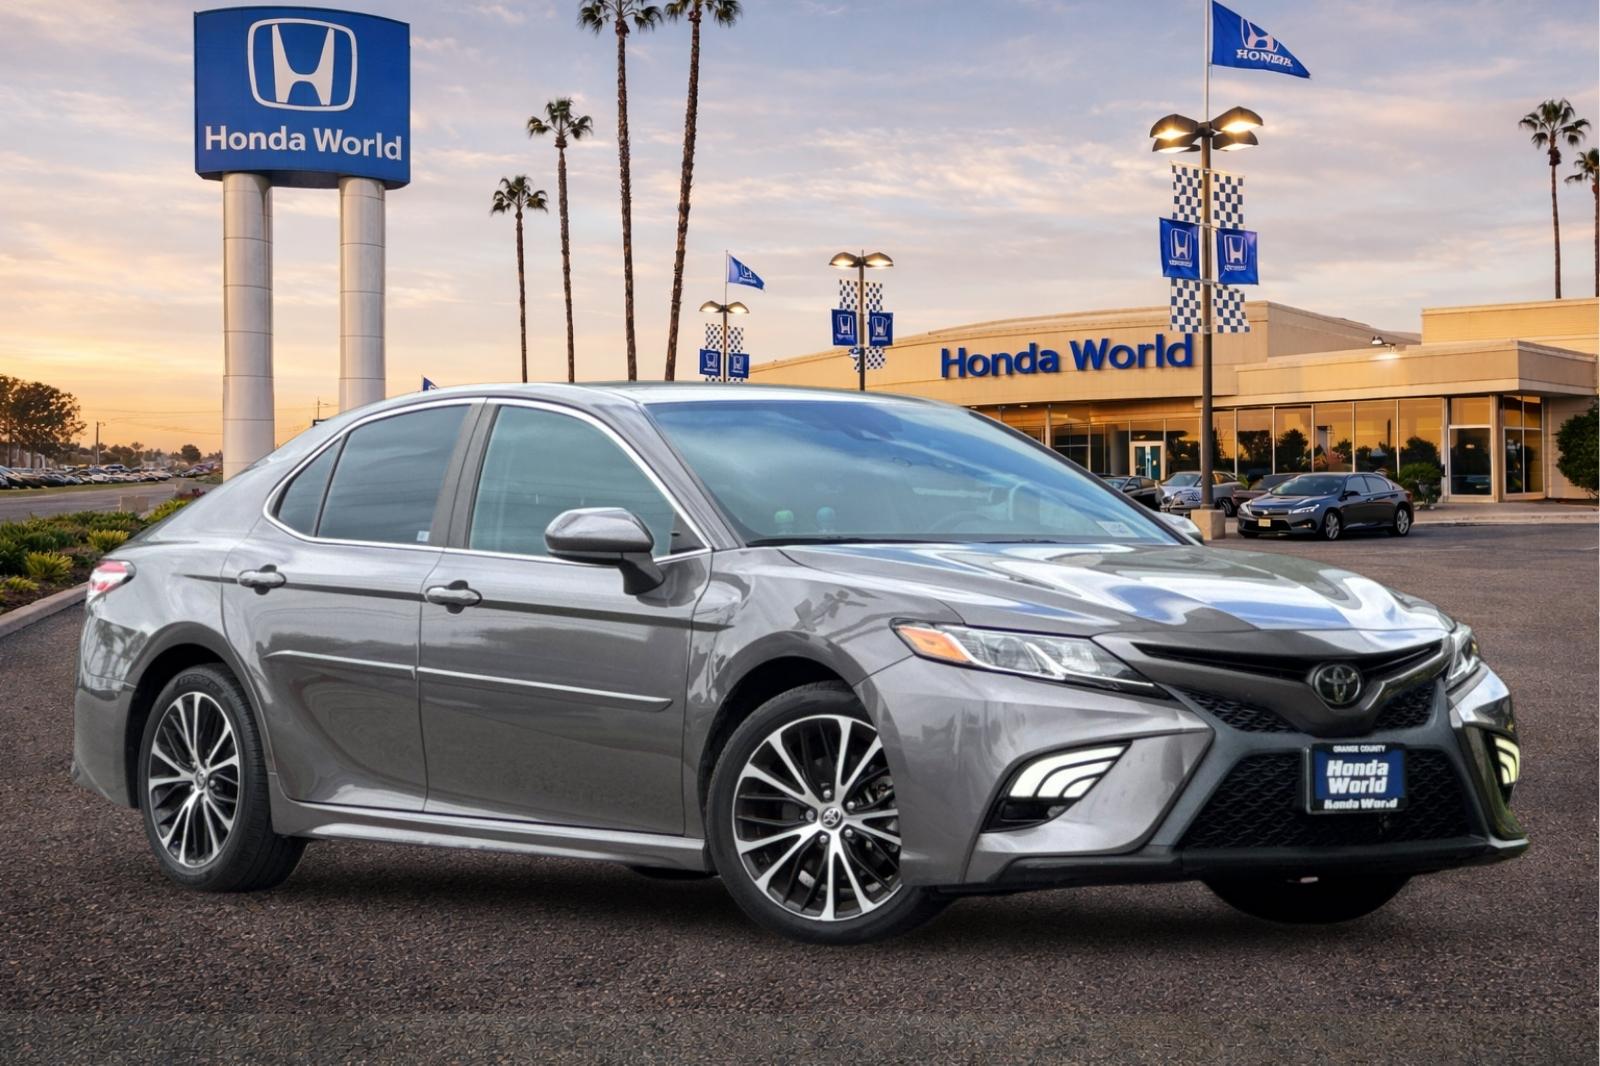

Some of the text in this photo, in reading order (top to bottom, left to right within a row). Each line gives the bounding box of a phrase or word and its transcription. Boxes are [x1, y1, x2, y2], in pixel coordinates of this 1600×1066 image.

[205, 125, 402, 161] Honda World
[941, 333, 1194, 379] Honda World
[1327, 759, 1389, 794] Honda World
